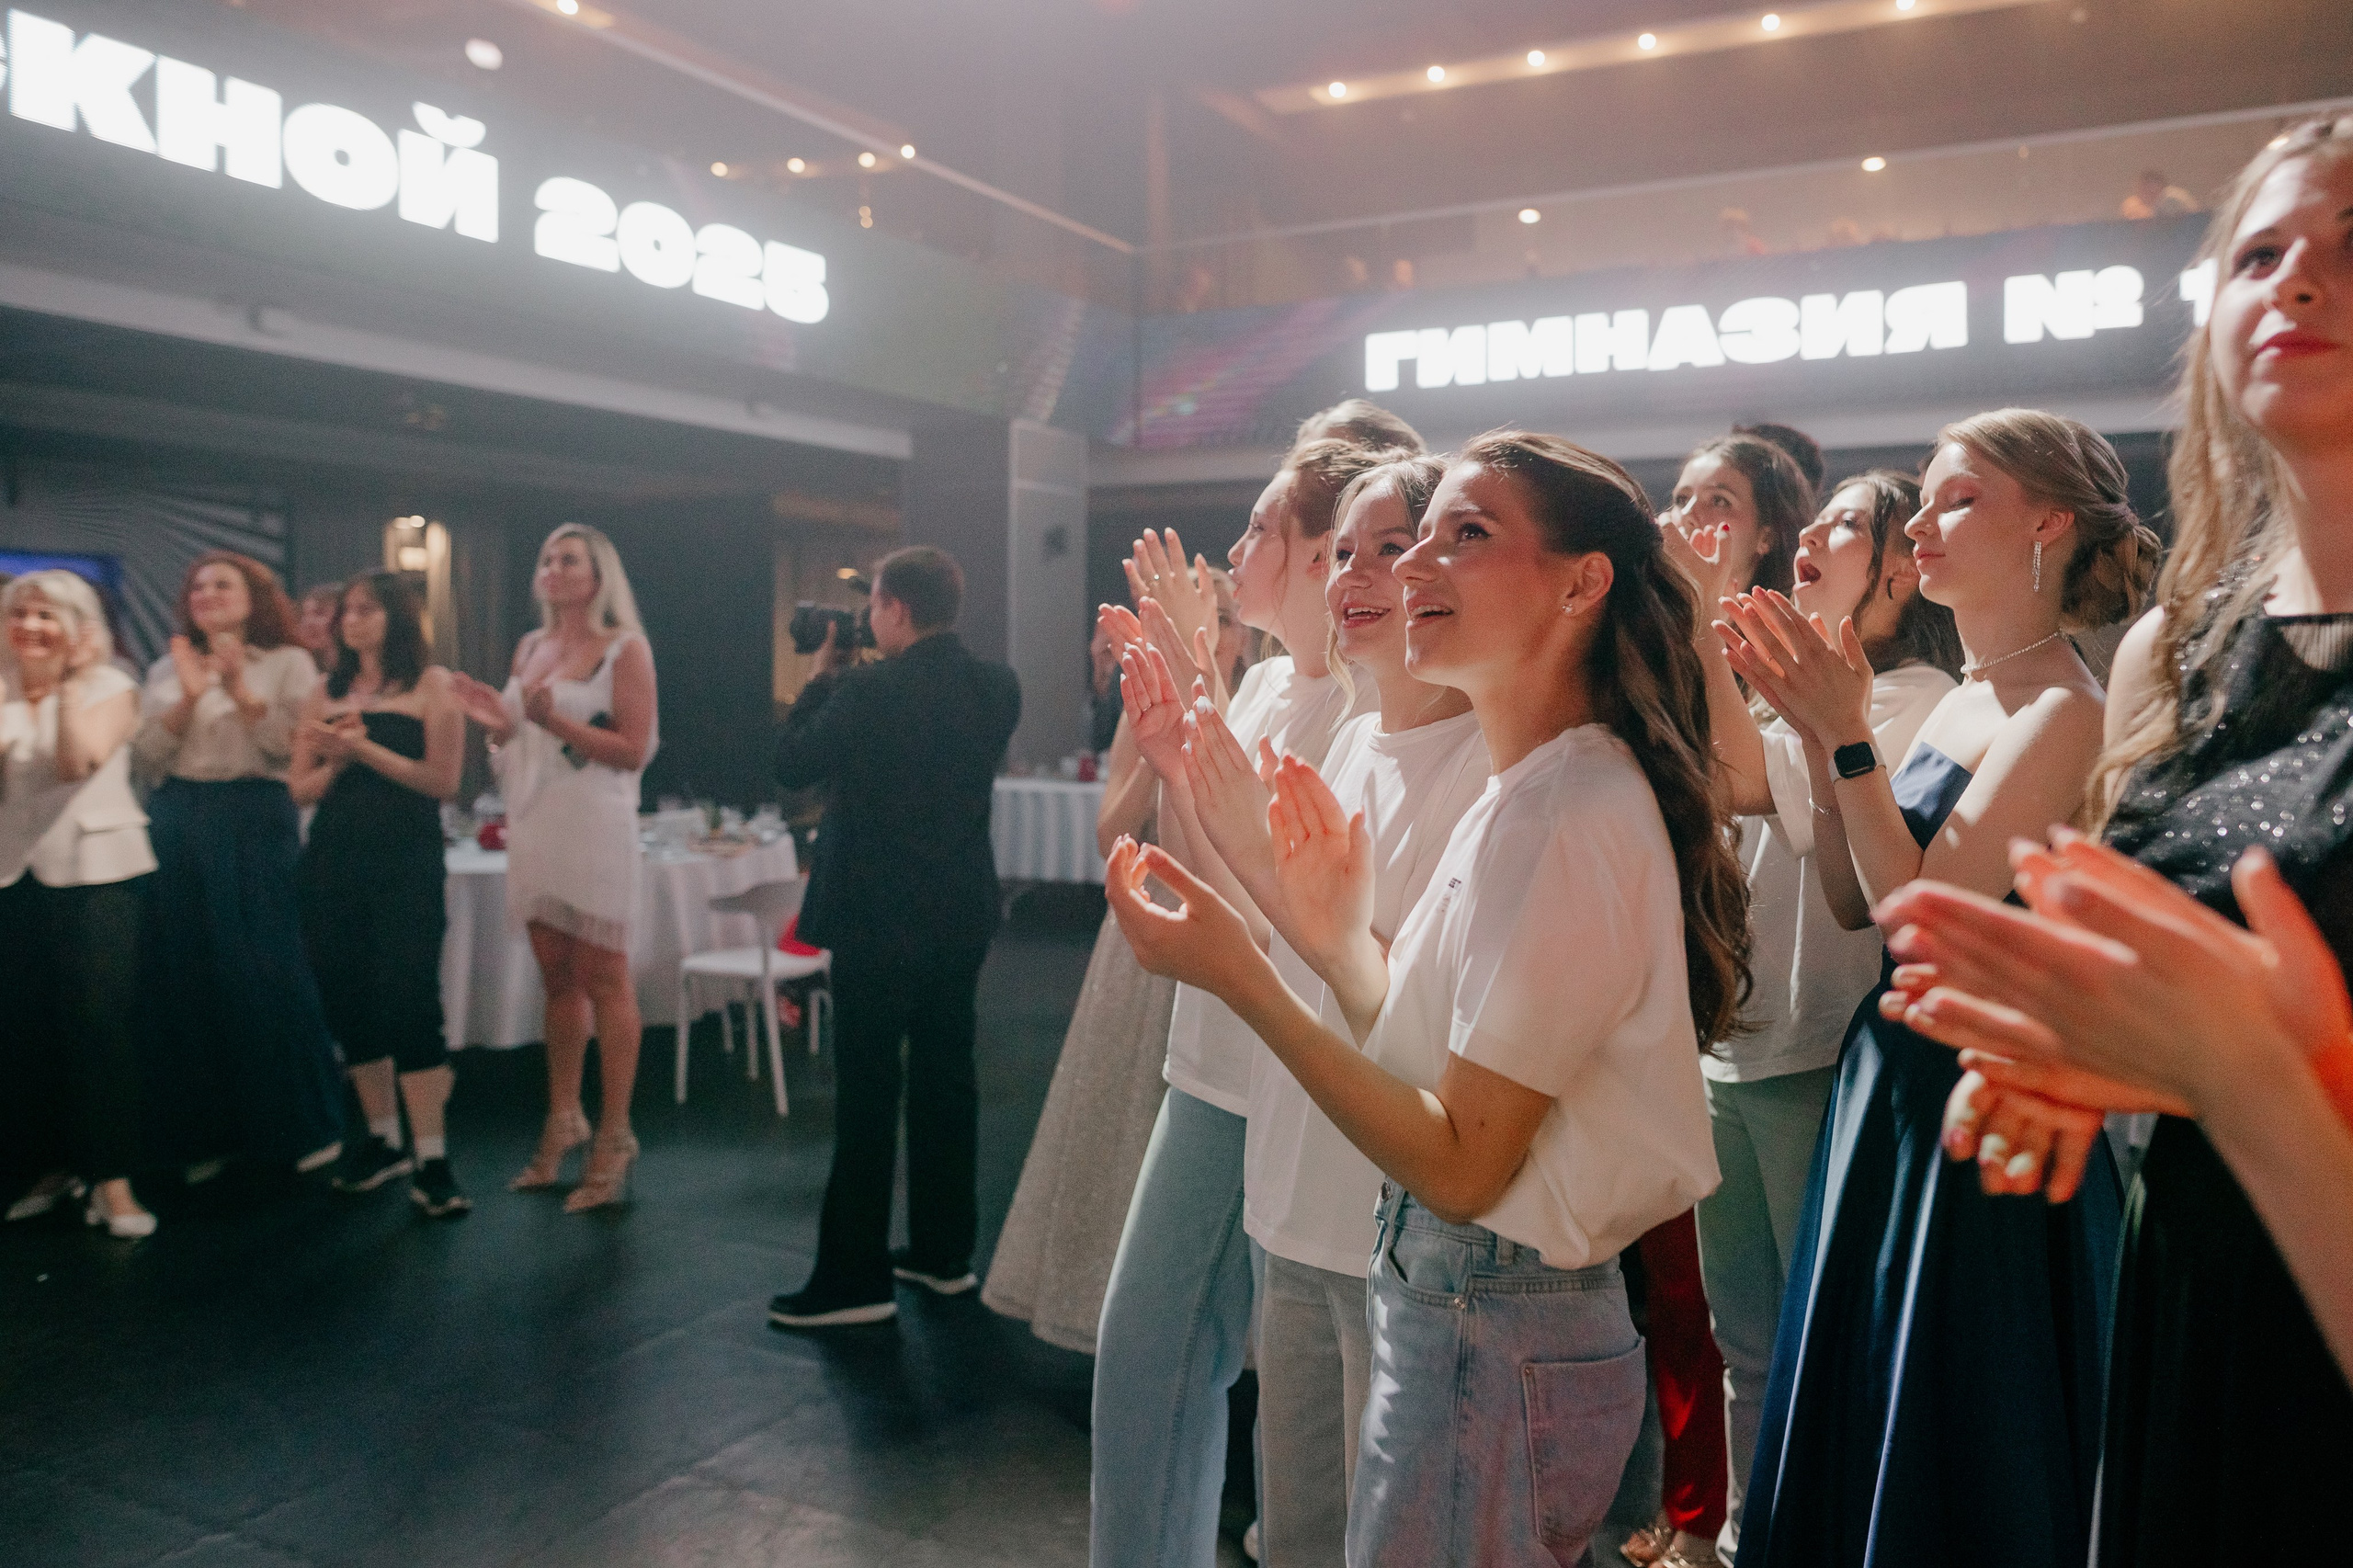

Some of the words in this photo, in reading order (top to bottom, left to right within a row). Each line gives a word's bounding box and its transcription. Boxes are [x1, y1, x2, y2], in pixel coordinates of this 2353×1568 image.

[0, 10, 499, 244] КНОЙ
[534, 176, 829, 324] 2025
[1365, 280, 1968, 392] ГИМНАЗИЯ
[2004, 265, 2143, 345] №
